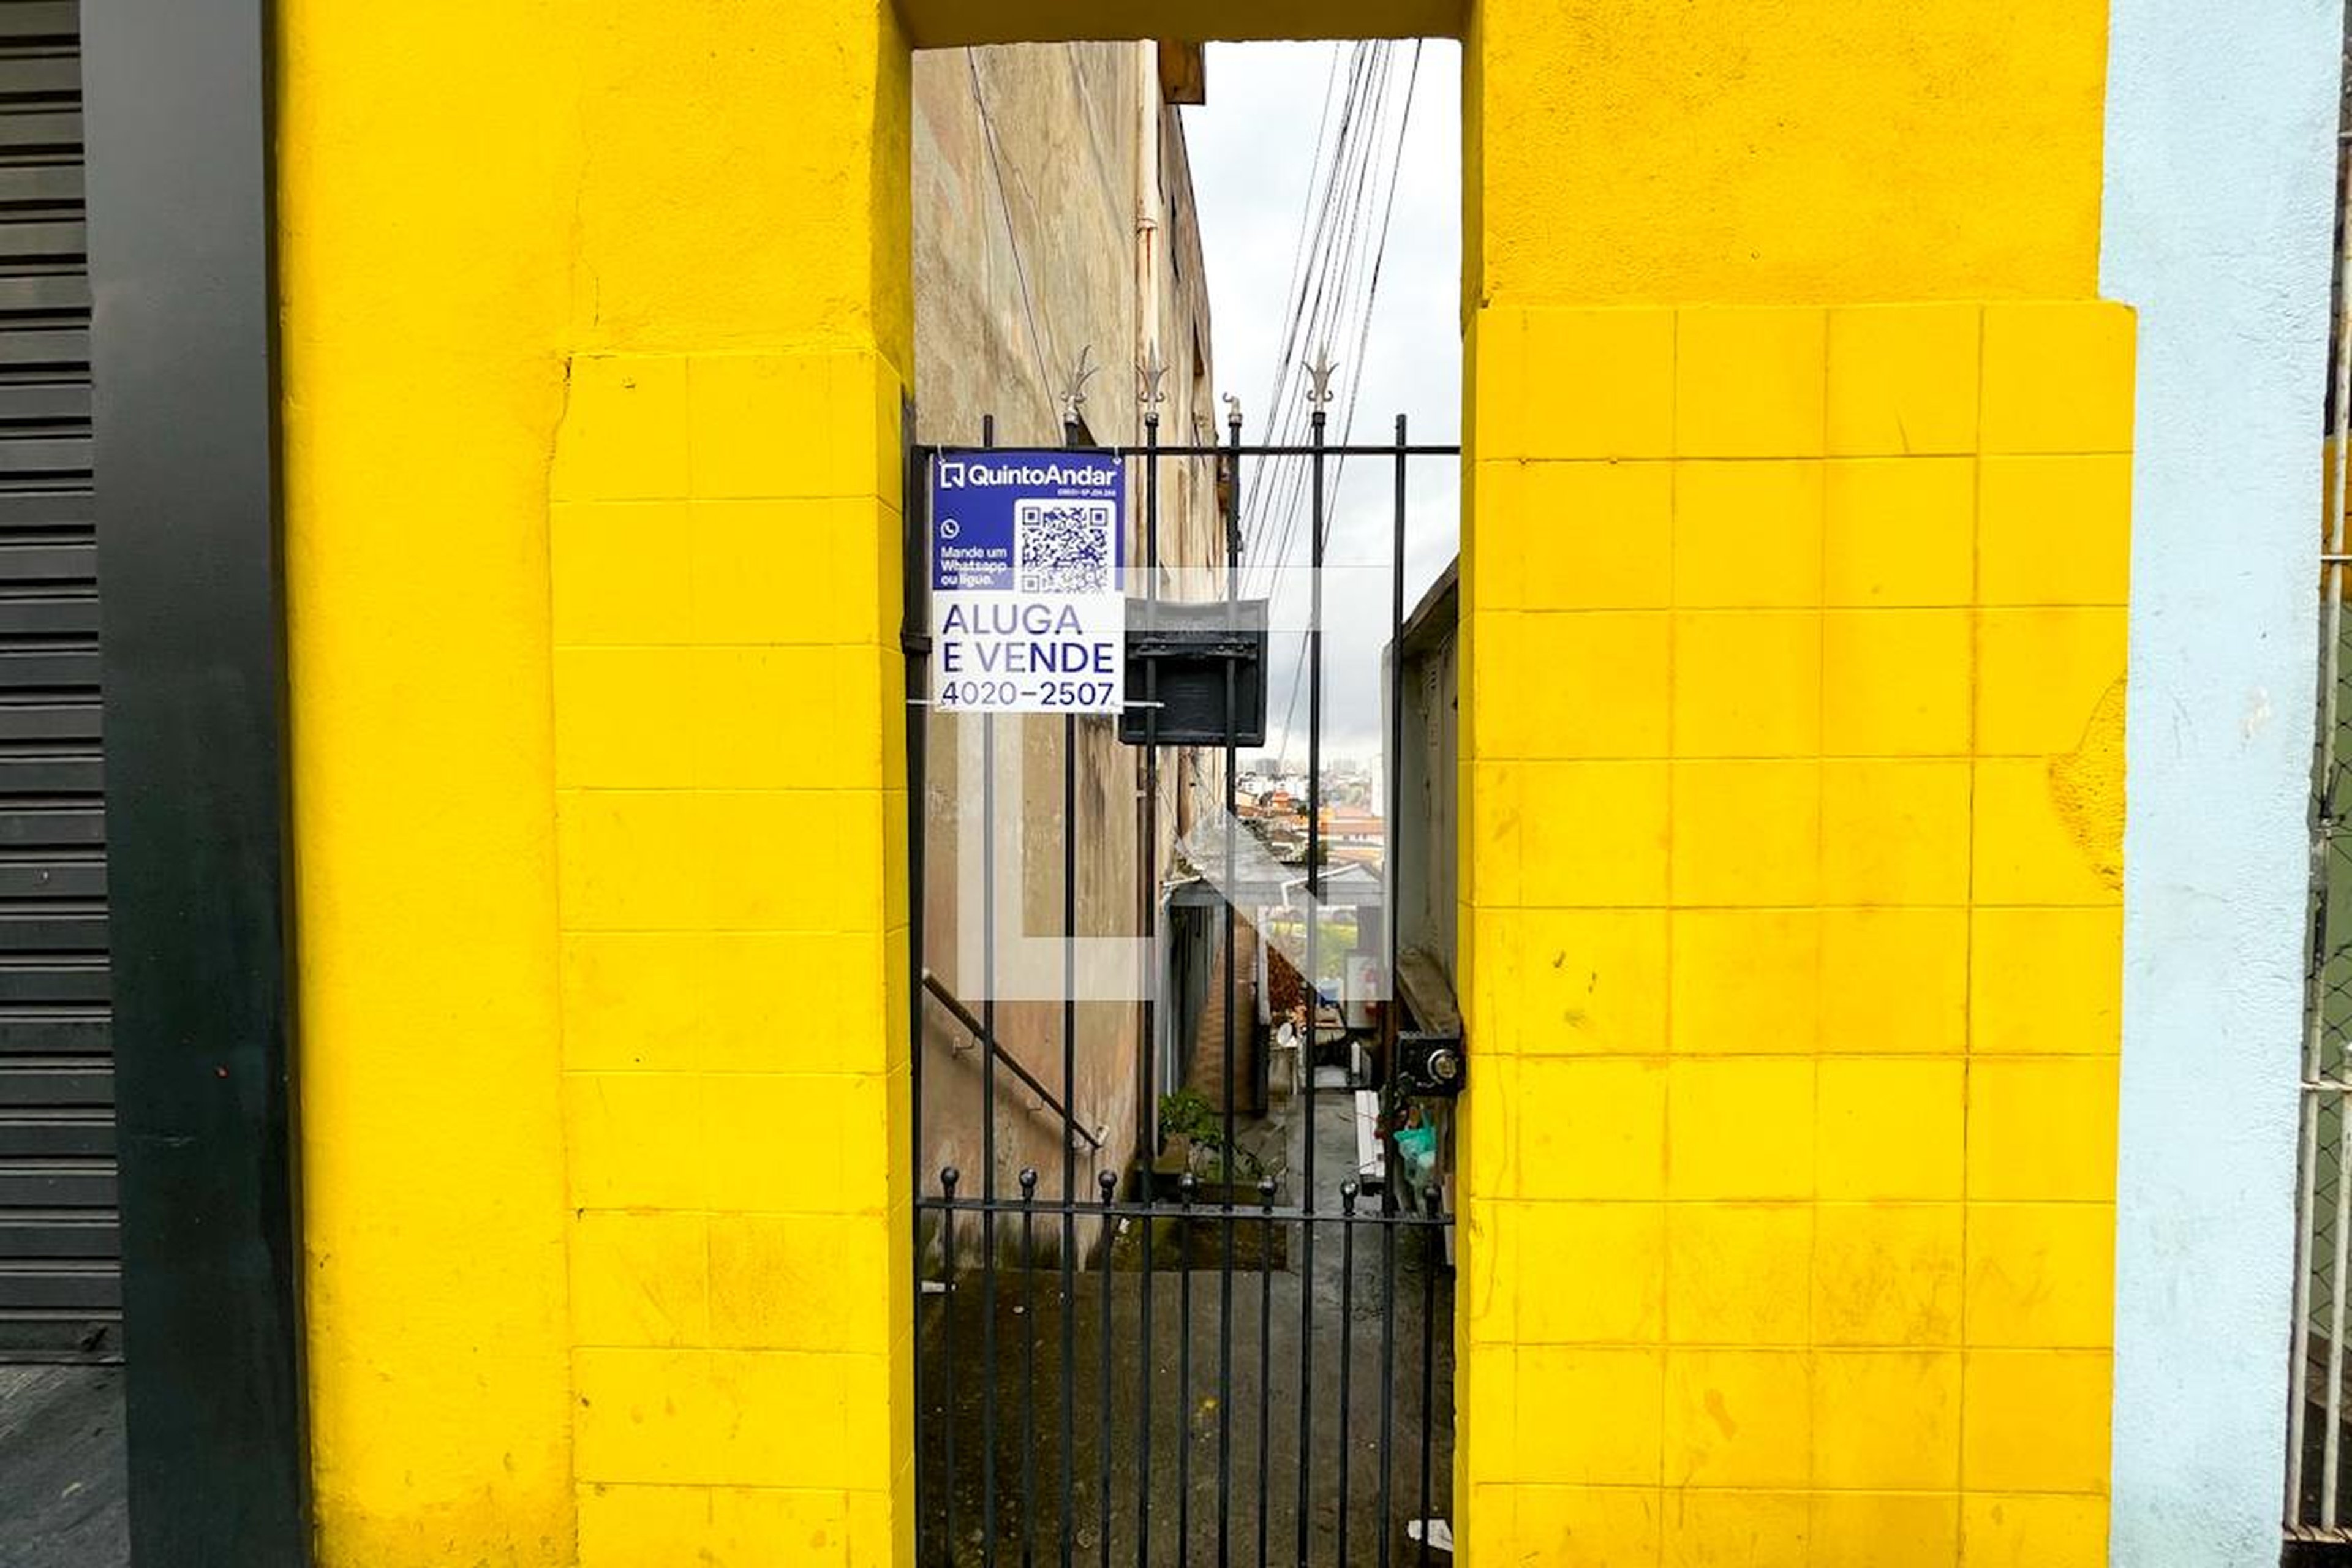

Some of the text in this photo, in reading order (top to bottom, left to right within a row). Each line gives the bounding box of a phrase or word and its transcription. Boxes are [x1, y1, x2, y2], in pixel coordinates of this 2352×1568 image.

[968, 464, 1117, 487] QuintoAndar
[941, 546, 1007, 558] Mande um
[941, 575, 957, 585] ou
[942, 604, 1082, 635] ALUGA
[944, 643, 1114, 673] E VENDE
[942, 682, 1114, 704] 4020-2507
